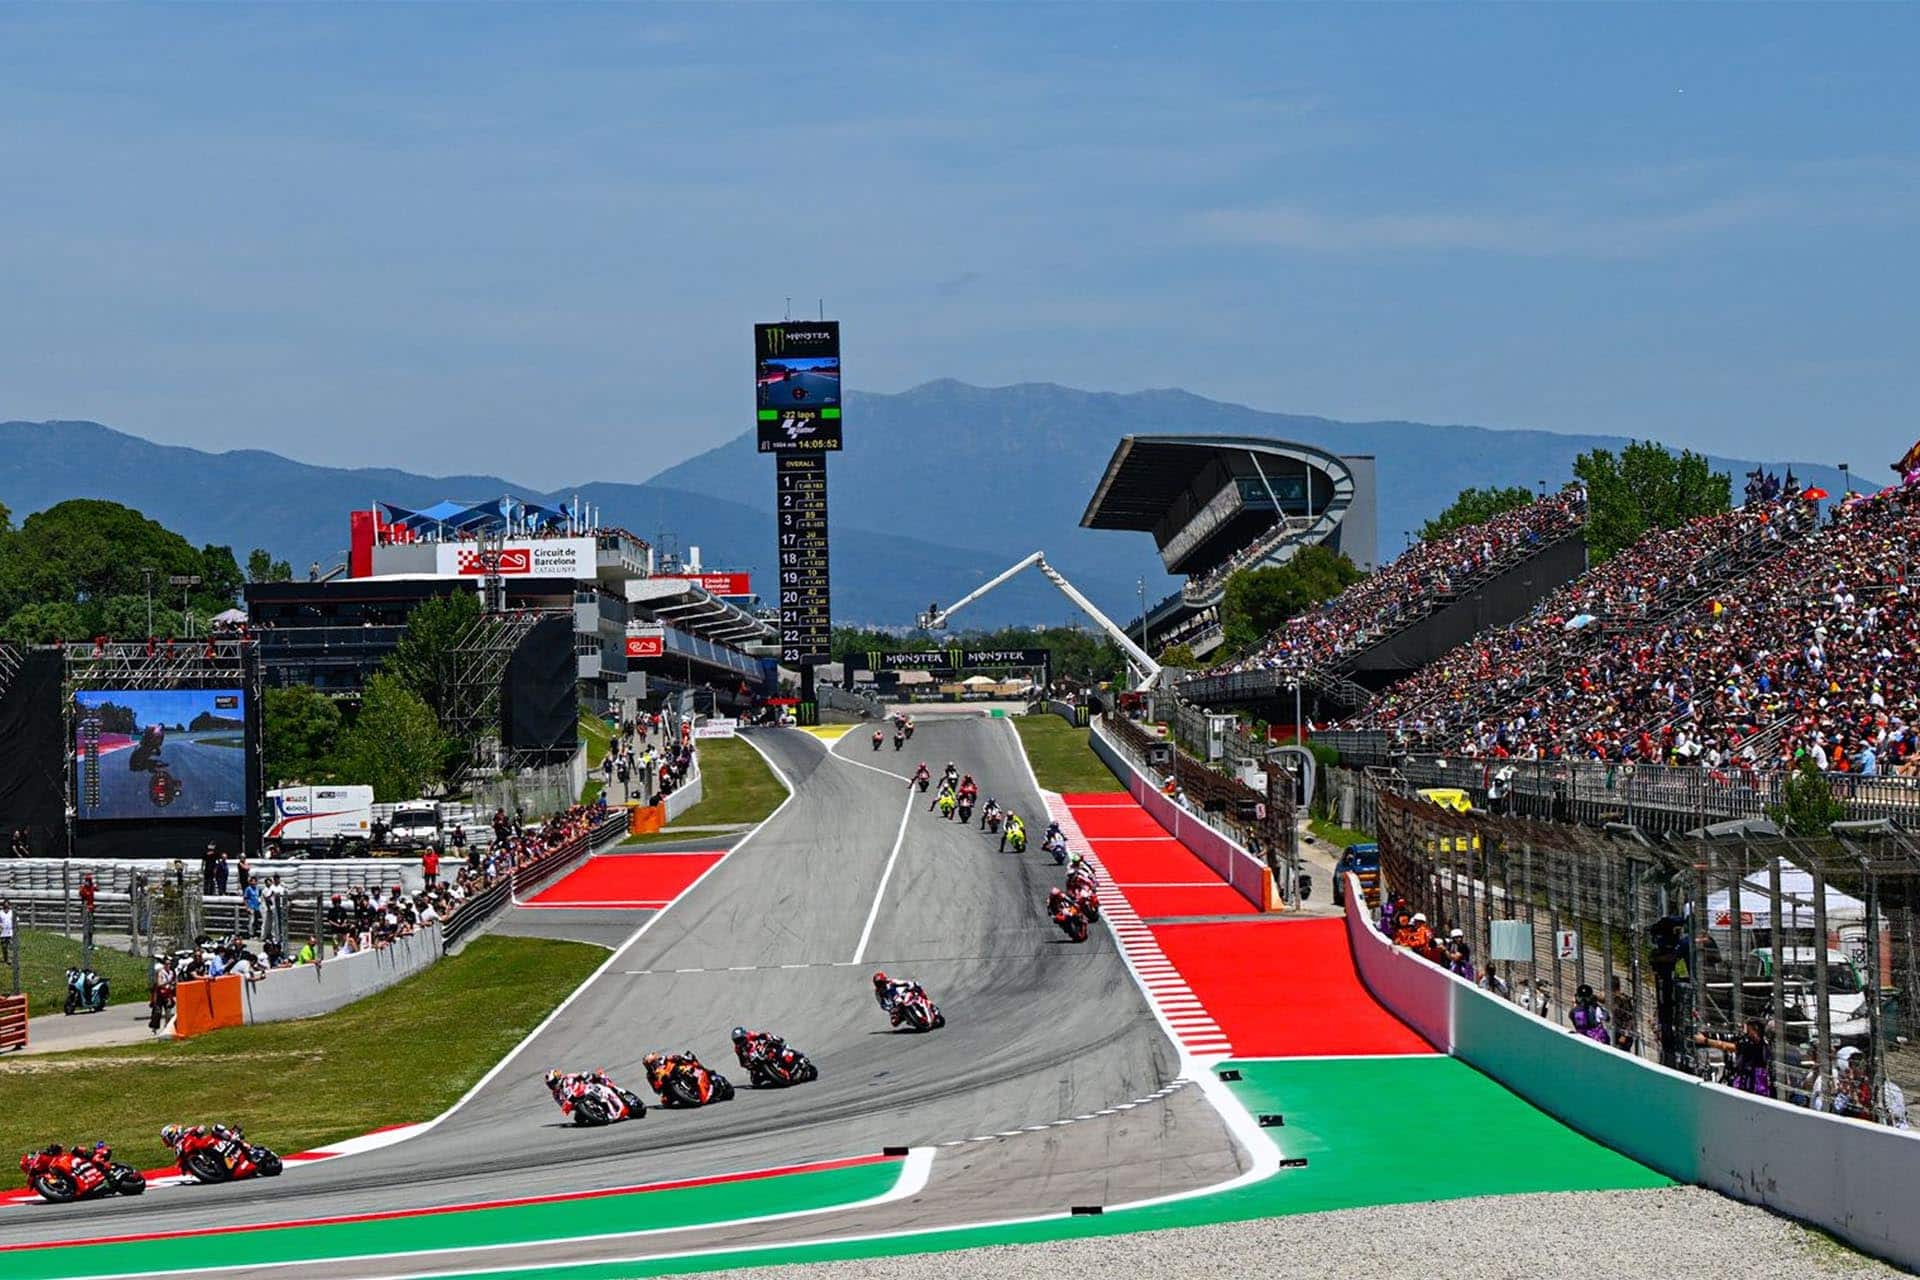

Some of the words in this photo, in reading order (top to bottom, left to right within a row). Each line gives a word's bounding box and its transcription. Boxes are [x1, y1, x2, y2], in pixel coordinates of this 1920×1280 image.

[786, 332, 830, 340] MONSTER
[784, 476, 790, 487] 1
[784, 495, 792, 506] 2
[784, 514, 792, 525] 3
[782, 534, 796, 545] 17
[534, 548, 564, 557] Circuit
[565, 548, 576, 557] de
[535, 558, 576, 566] Barcelona
[783, 553, 797, 564] 18
[783, 572, 797, 583] 19
[783, 591, 798, 603] 20
[783, 611, 797, 622] 21
[784, 630, 799, 641] 22
[784, 649, 799, 661] 23
[886, 653, 943, 664] MONSTER
[968, 651, 1025, 662] MONSTER
